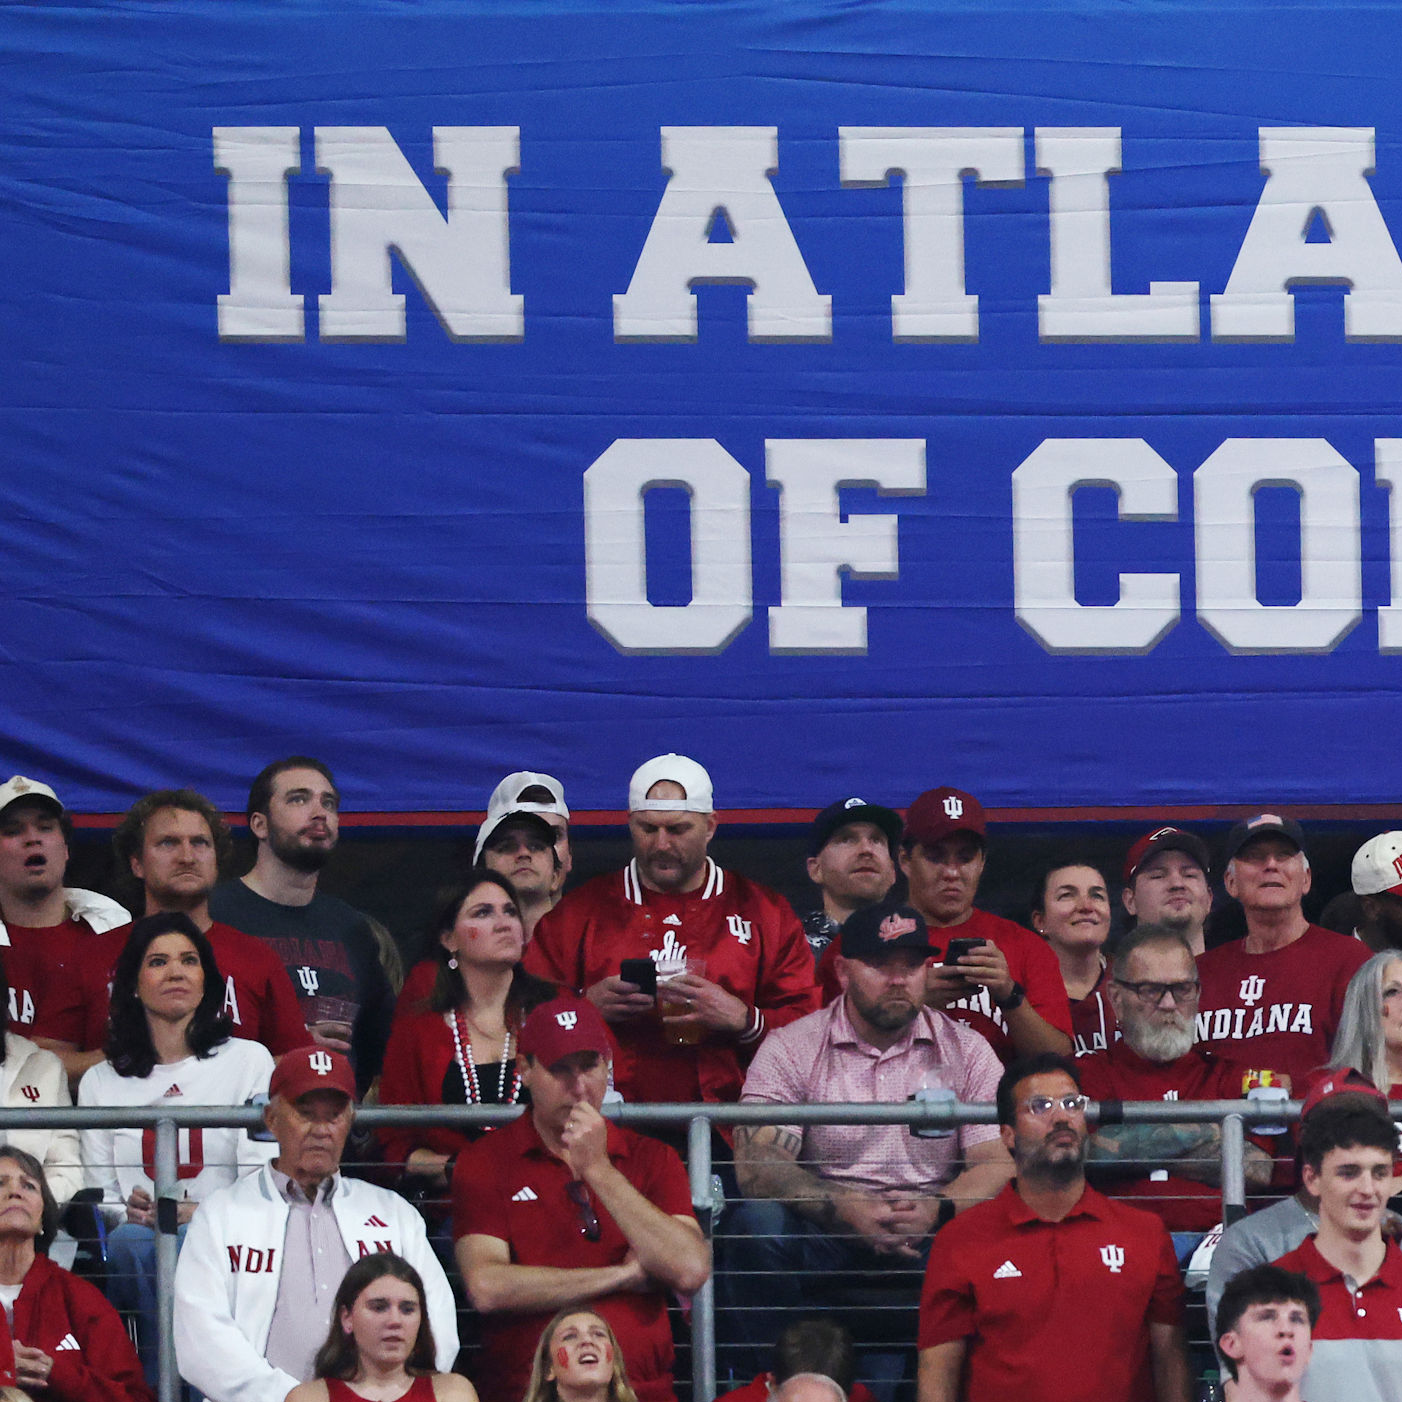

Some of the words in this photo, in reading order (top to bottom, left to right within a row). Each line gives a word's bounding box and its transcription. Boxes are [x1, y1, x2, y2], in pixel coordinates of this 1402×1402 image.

[213, 126, 526, 341] IN
[584, 438, 928, 652] OF
[1194, 1002, 1313, 1041] NDIANA
